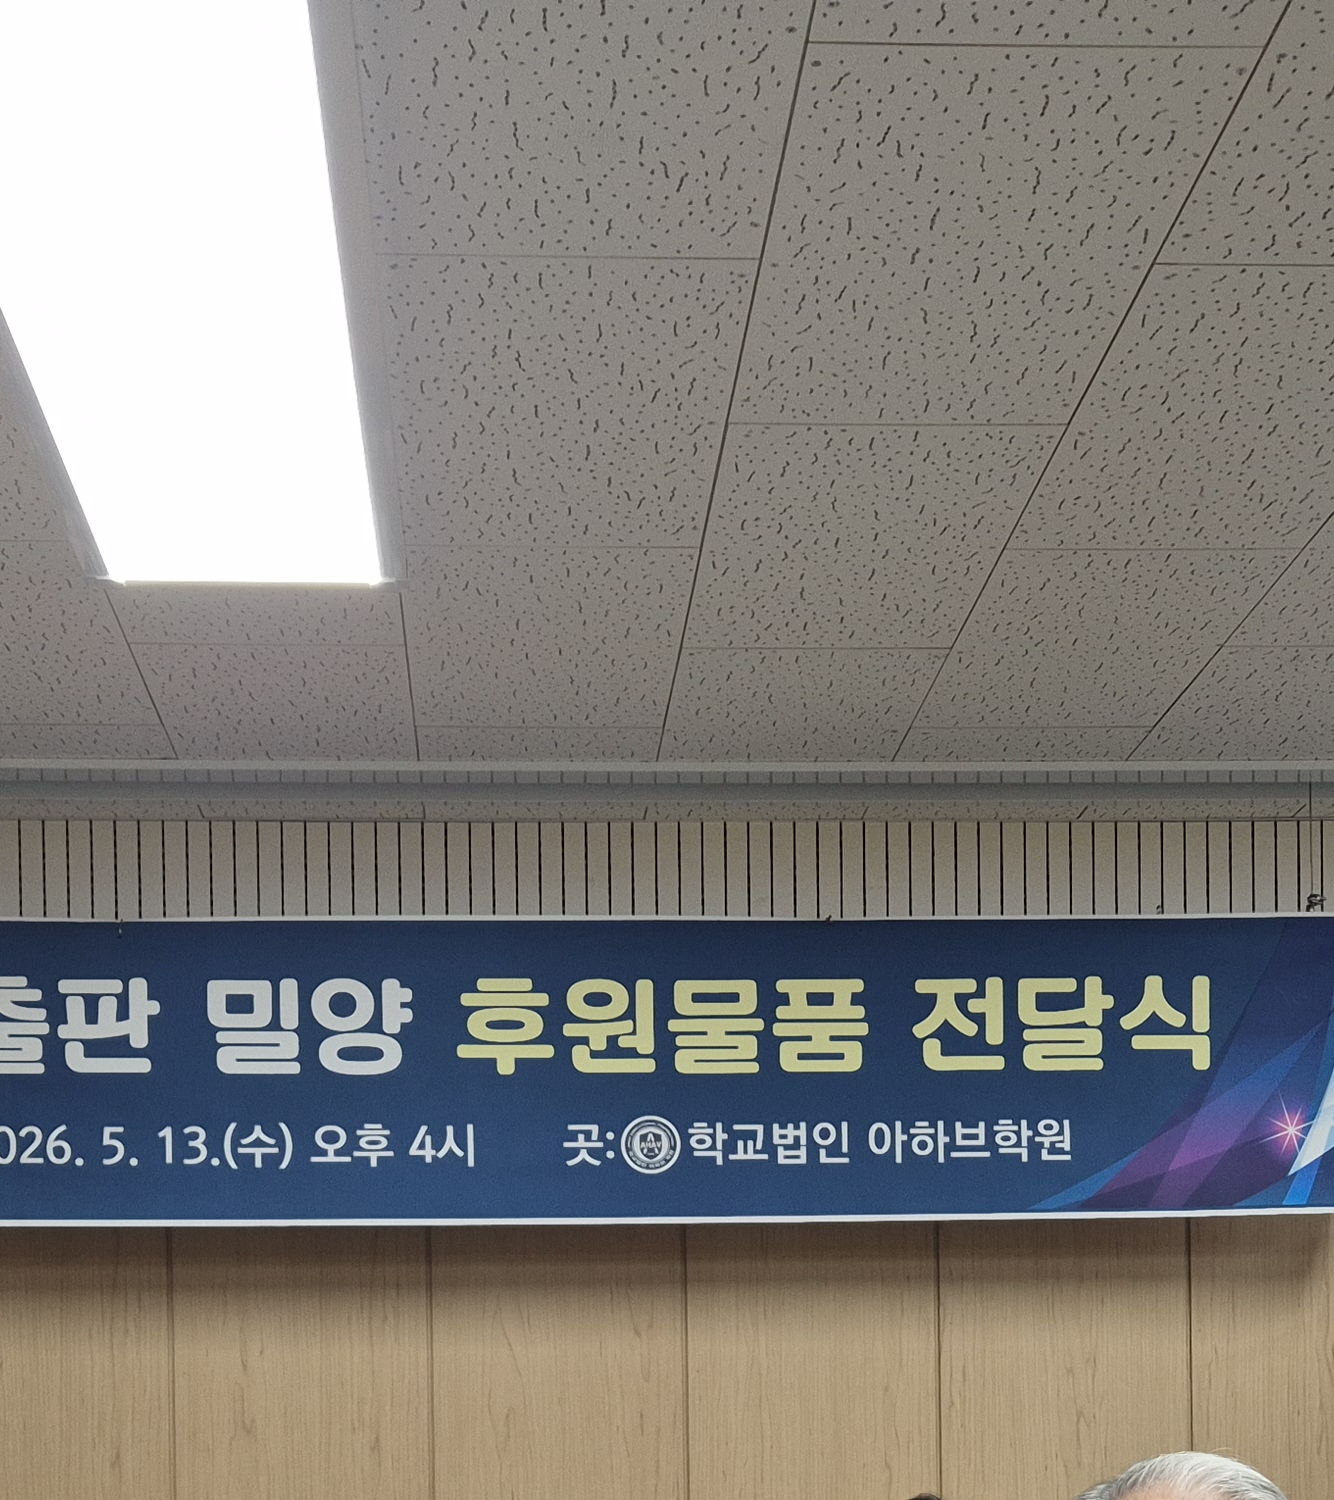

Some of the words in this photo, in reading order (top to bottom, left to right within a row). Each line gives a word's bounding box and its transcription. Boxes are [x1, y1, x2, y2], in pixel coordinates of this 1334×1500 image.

[205, 977, 414, 1076] 밀양
[455, 976, 870, 1076] 후원물품
[911, 974, 1211, 1072] 전달식
[100, 1125, 139, 1166] 5.
[156, 1121, 294, 1170] 13.(수)
[308, 1123, 395, 1168] 오후
[408, 1122, 476, 1168] 4시
[562, 1123, 616, 1167] 곳:
[687, 1120, 851, 1166] 학교법인
[867, 1118, 1073, 1164] 아하브학원
